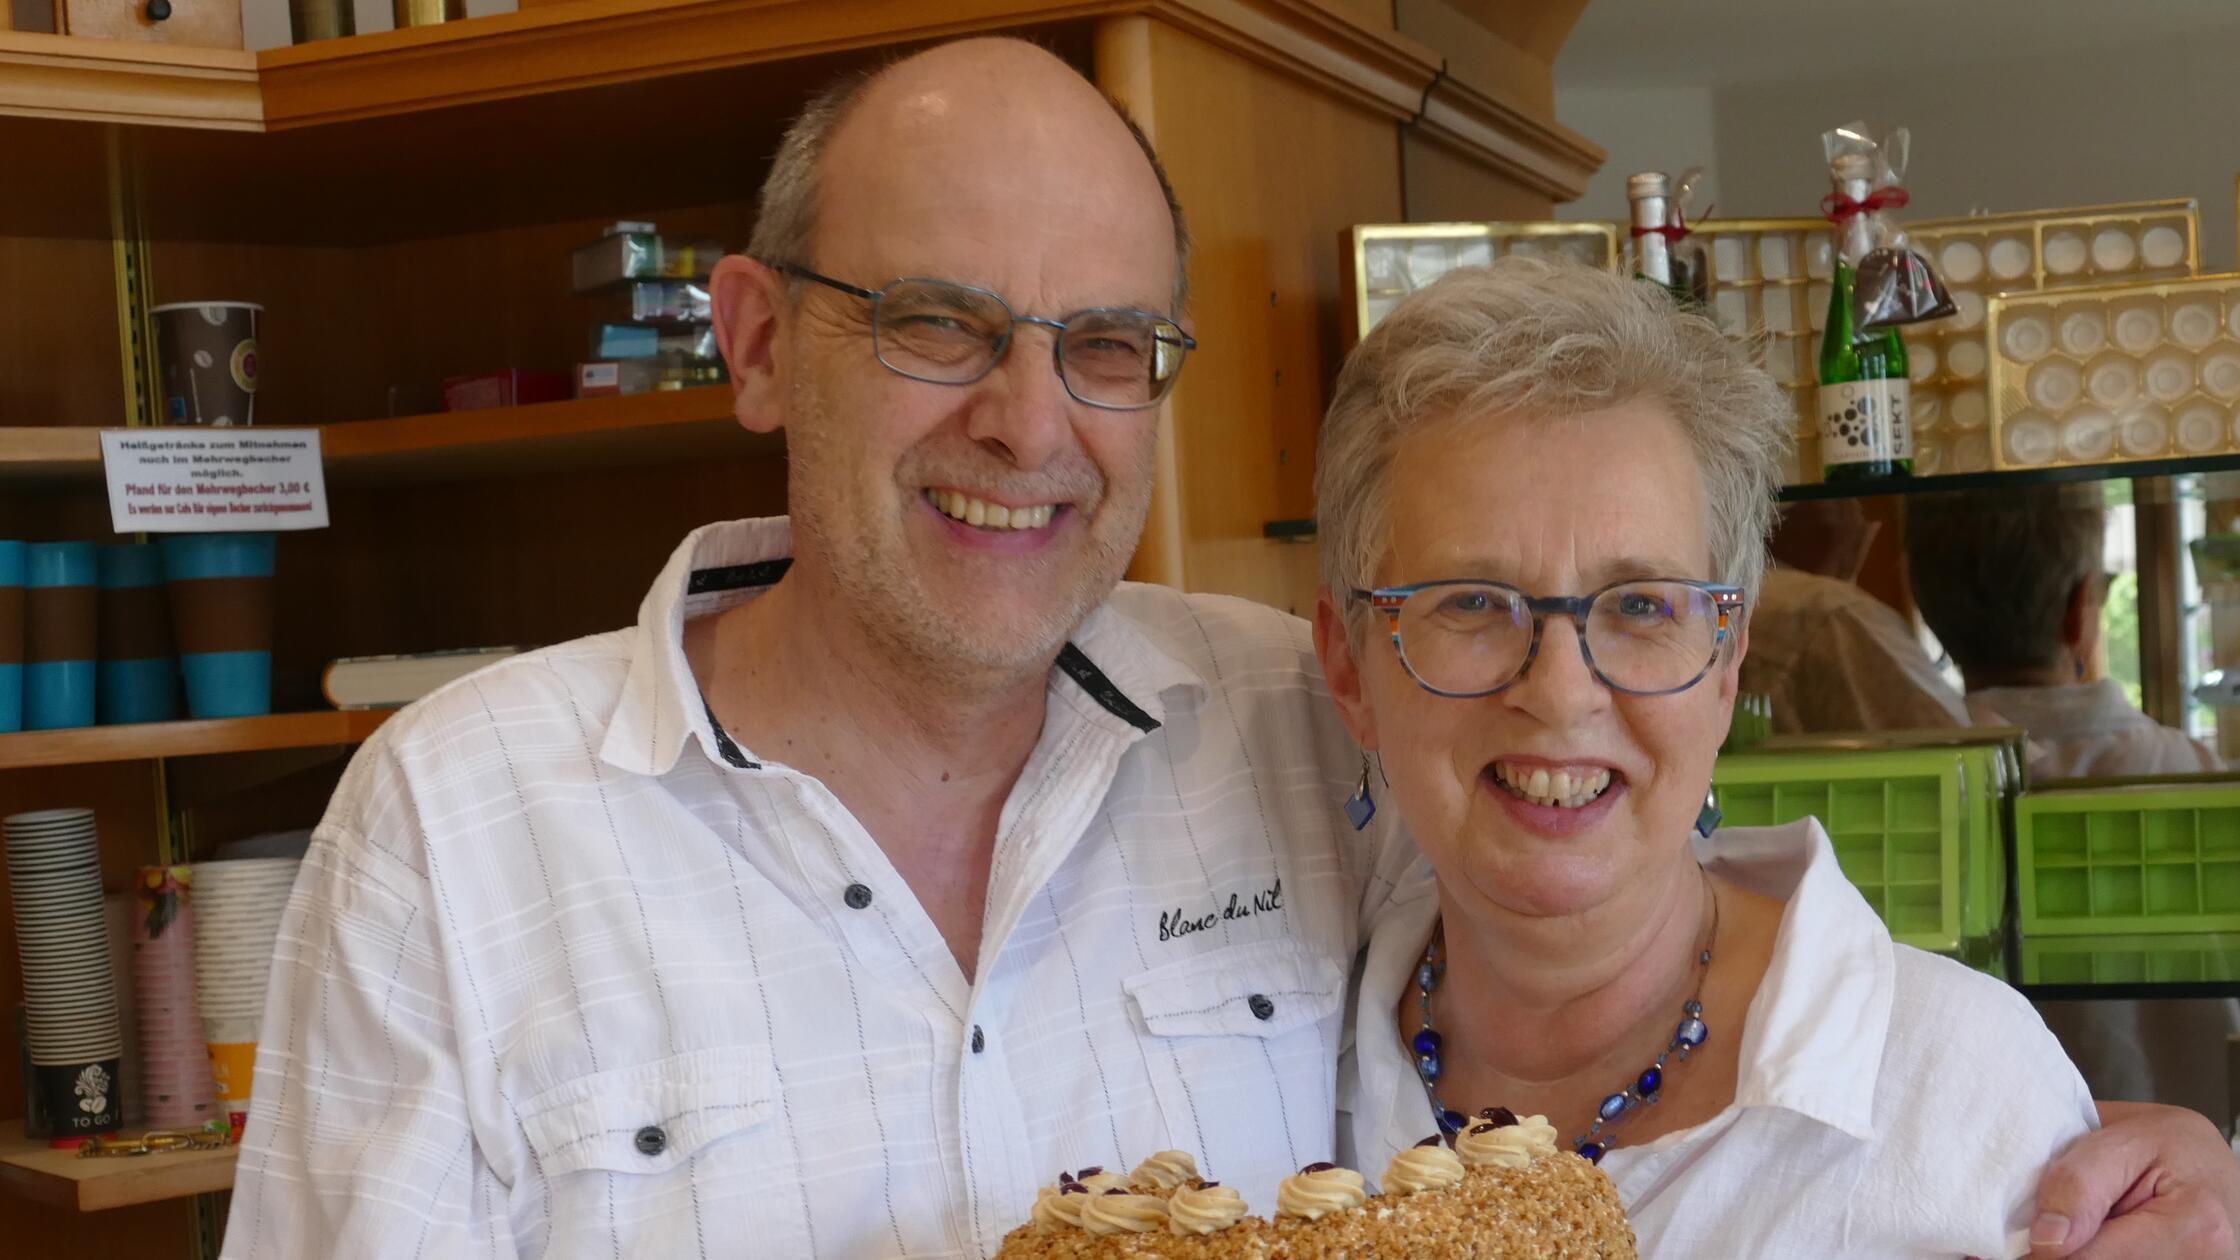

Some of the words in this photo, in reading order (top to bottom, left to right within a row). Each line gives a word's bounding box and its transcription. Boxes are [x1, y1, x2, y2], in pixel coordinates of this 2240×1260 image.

[1891, 395, 1903, 455] SEKT
[120, 440, 205, 451] Heißgetränke
[210, 441, 235, 450] zum
[239, 439, 307, 449] Mitnehmen
[139, 455, 169, 465] auch
[173, 455, 188, 464] im
[192, 454, 291, 466] Mehrwegbecher
[191, 468, 244, 479] möglich.
[125, 484, 155, 496] Pfand
[158, 483, 171, 495] für
[175, 483, 193, 495] den
[196, 483, 276, 497] Mehrwegbecher
[279, 482, 300, 495] 3,00
[303, 482, 310, 493] €
[1159, 908, 1220, 941] Blanc
[1223, 893, 1250, 919] du
[1254, 879, 1281, 916] Nil
[72, 1117, 91, 1128] TO
[94, 1114, 111, 1126] GO
